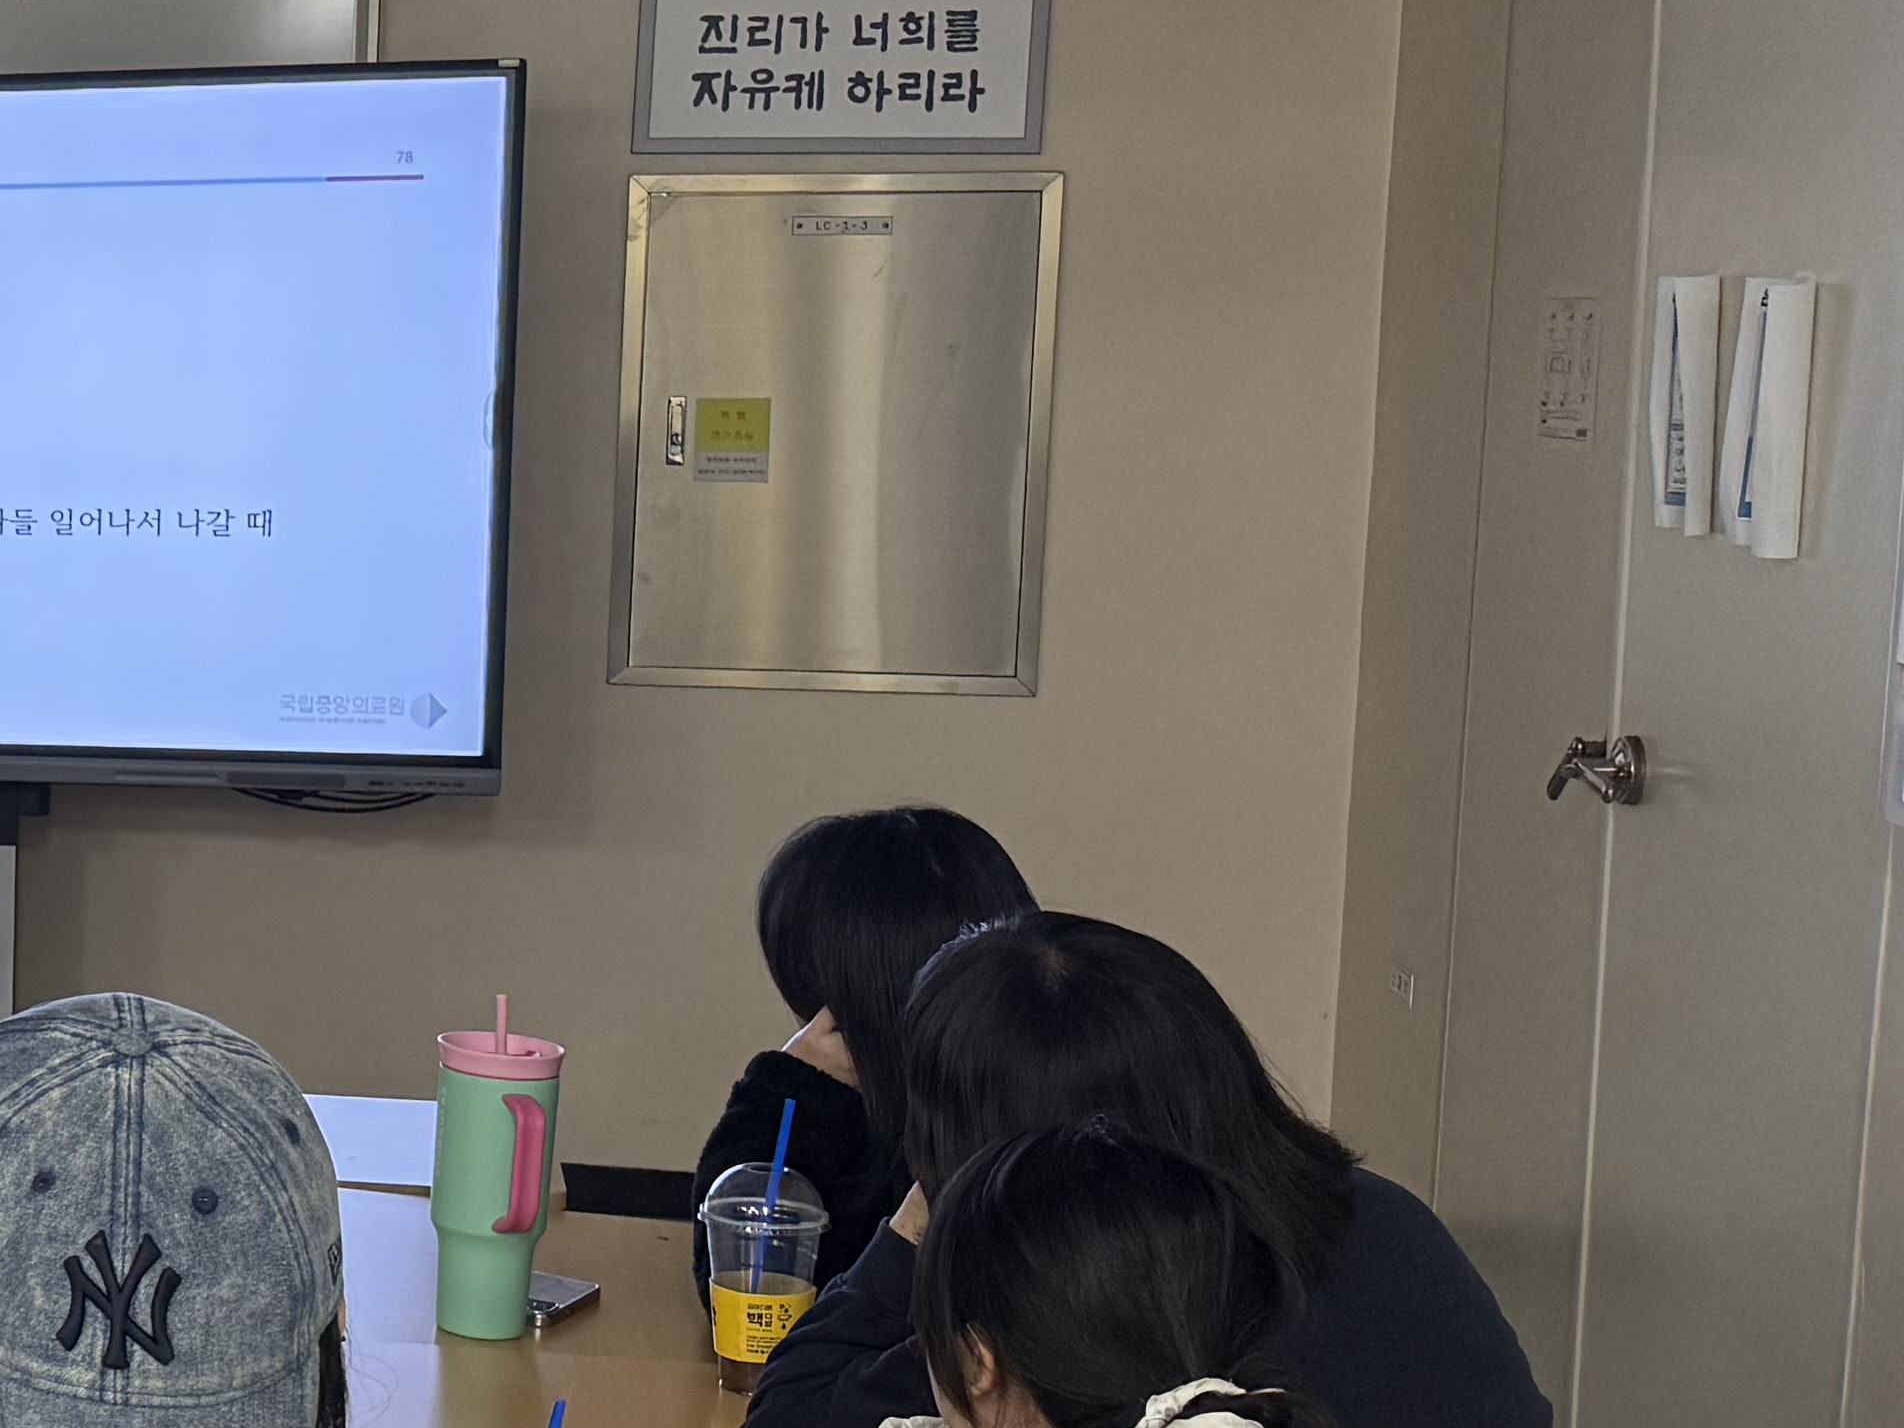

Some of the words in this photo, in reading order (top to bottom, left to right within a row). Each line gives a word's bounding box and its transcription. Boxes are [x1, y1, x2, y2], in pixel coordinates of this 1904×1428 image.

[698, 11, 829, 55] 진리가
[852, 10, 980, 53] 너희를
[692, 68, 824, 112] 자유케
[847, 69, 985, 113] 하리라
[51, 508, 161, 536] 일어나서
[178, 509, 236, 537] 나갈
[247, 509, 272, 537] 때
[279, 694, 405, 716] 국립중앙의료원
